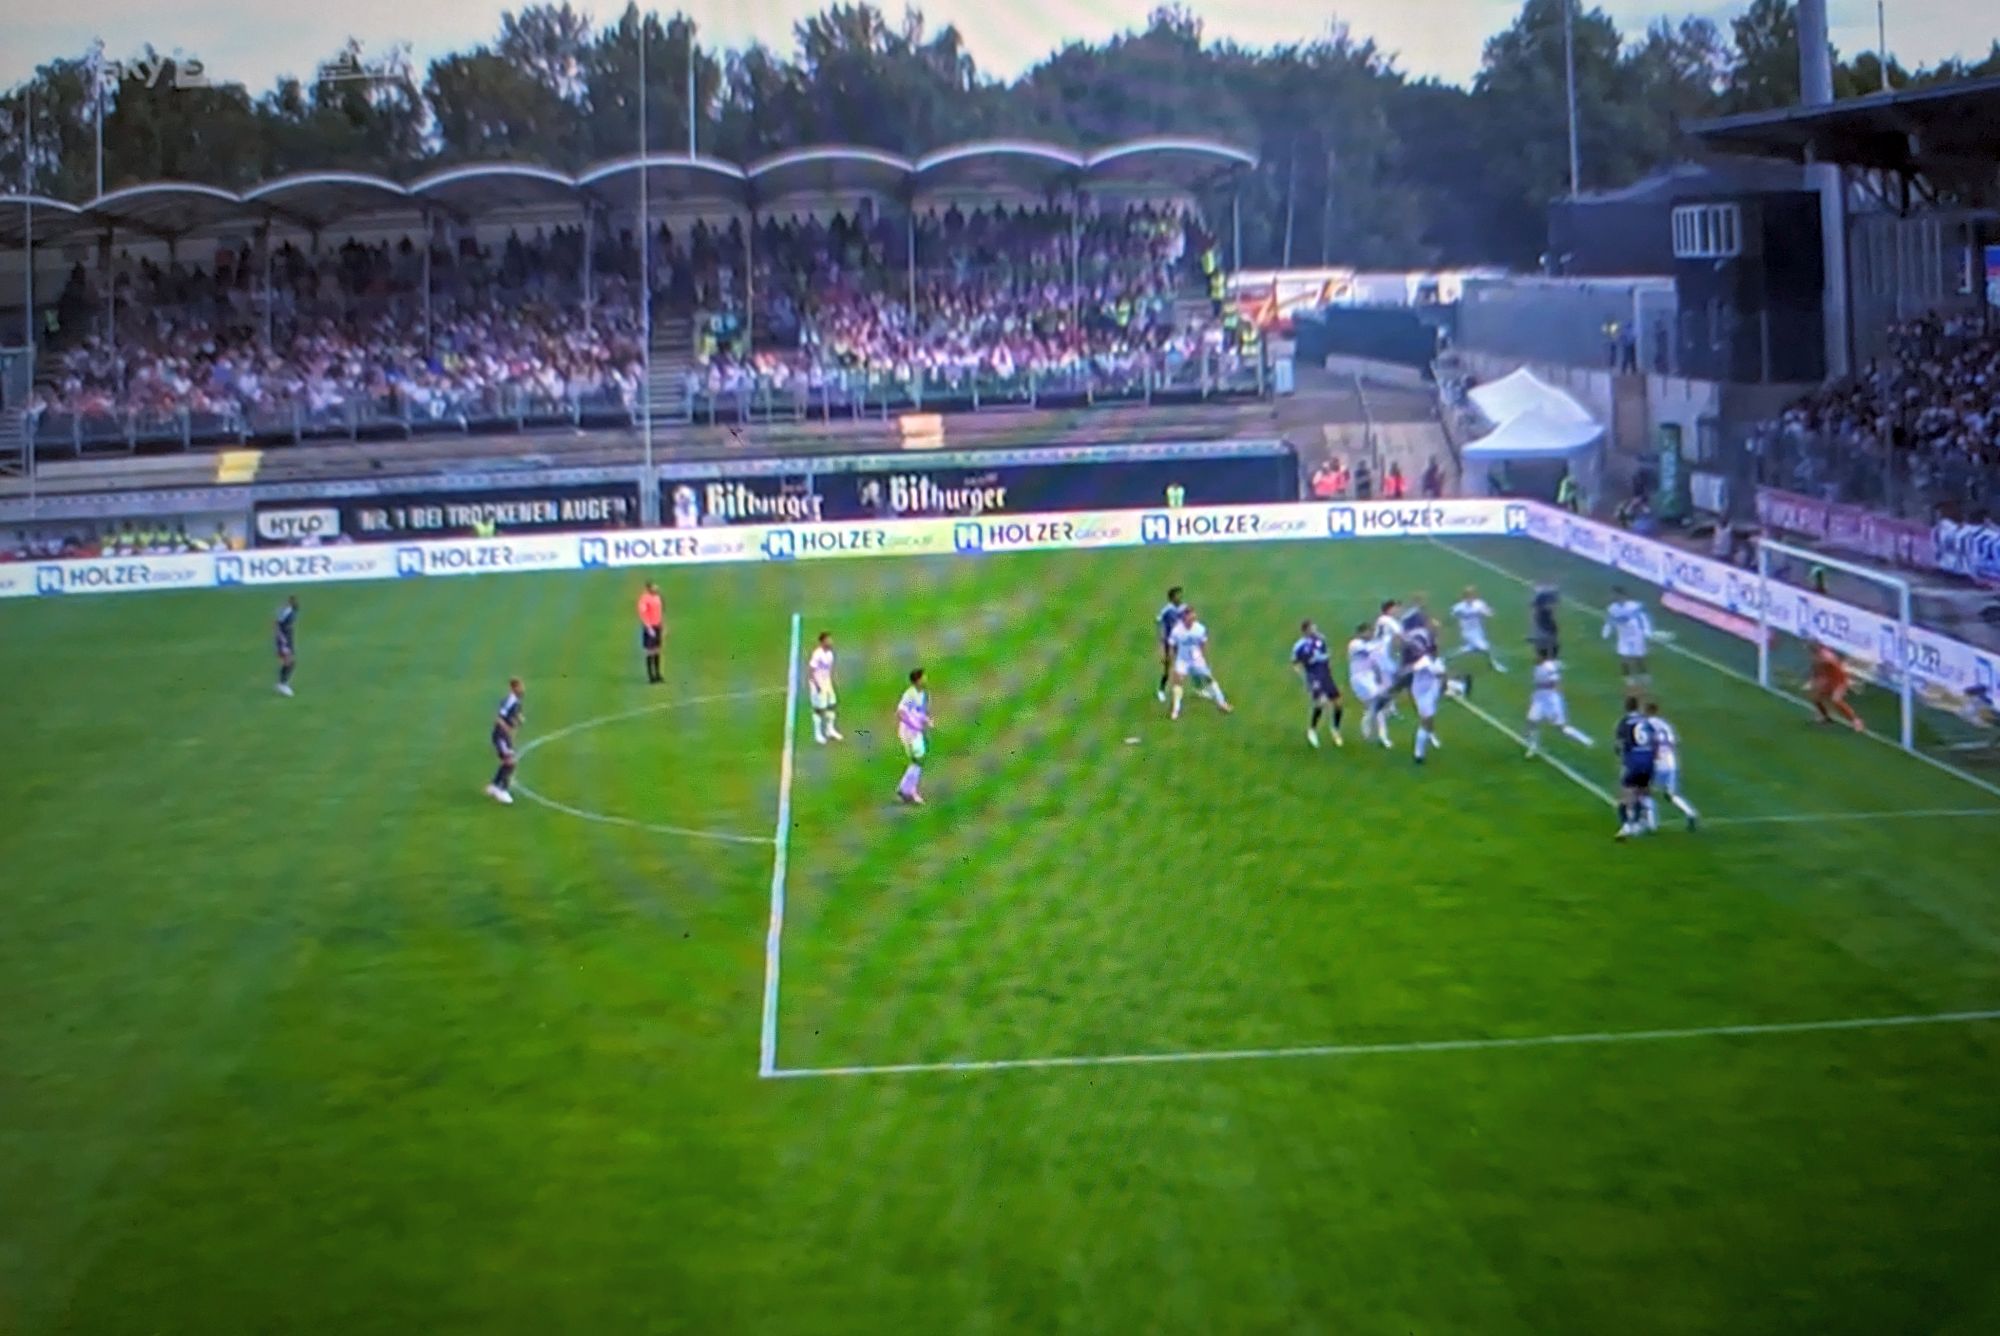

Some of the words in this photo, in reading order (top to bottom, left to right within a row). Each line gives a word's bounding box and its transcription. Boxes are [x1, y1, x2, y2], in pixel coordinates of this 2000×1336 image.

[890, 474, 1007, 515] Bitburger
[412, 506, 443, 529] BEI
[1177, 513, 1260, 534] HOLZER
[1363, 507, 1444, 528] HOLZER
[802, 530, 885, 550] HOLZER
[990, 523, 1073, 543] HOLZER
[431, 547, 514, 568] HOLZER
[614, 537, 699, 558] HOLZER
[70, 565, 149, 586] HOLZER
[250, 556, 332, 577] HOLZER
[1633, 722, 1648, 745] 6
